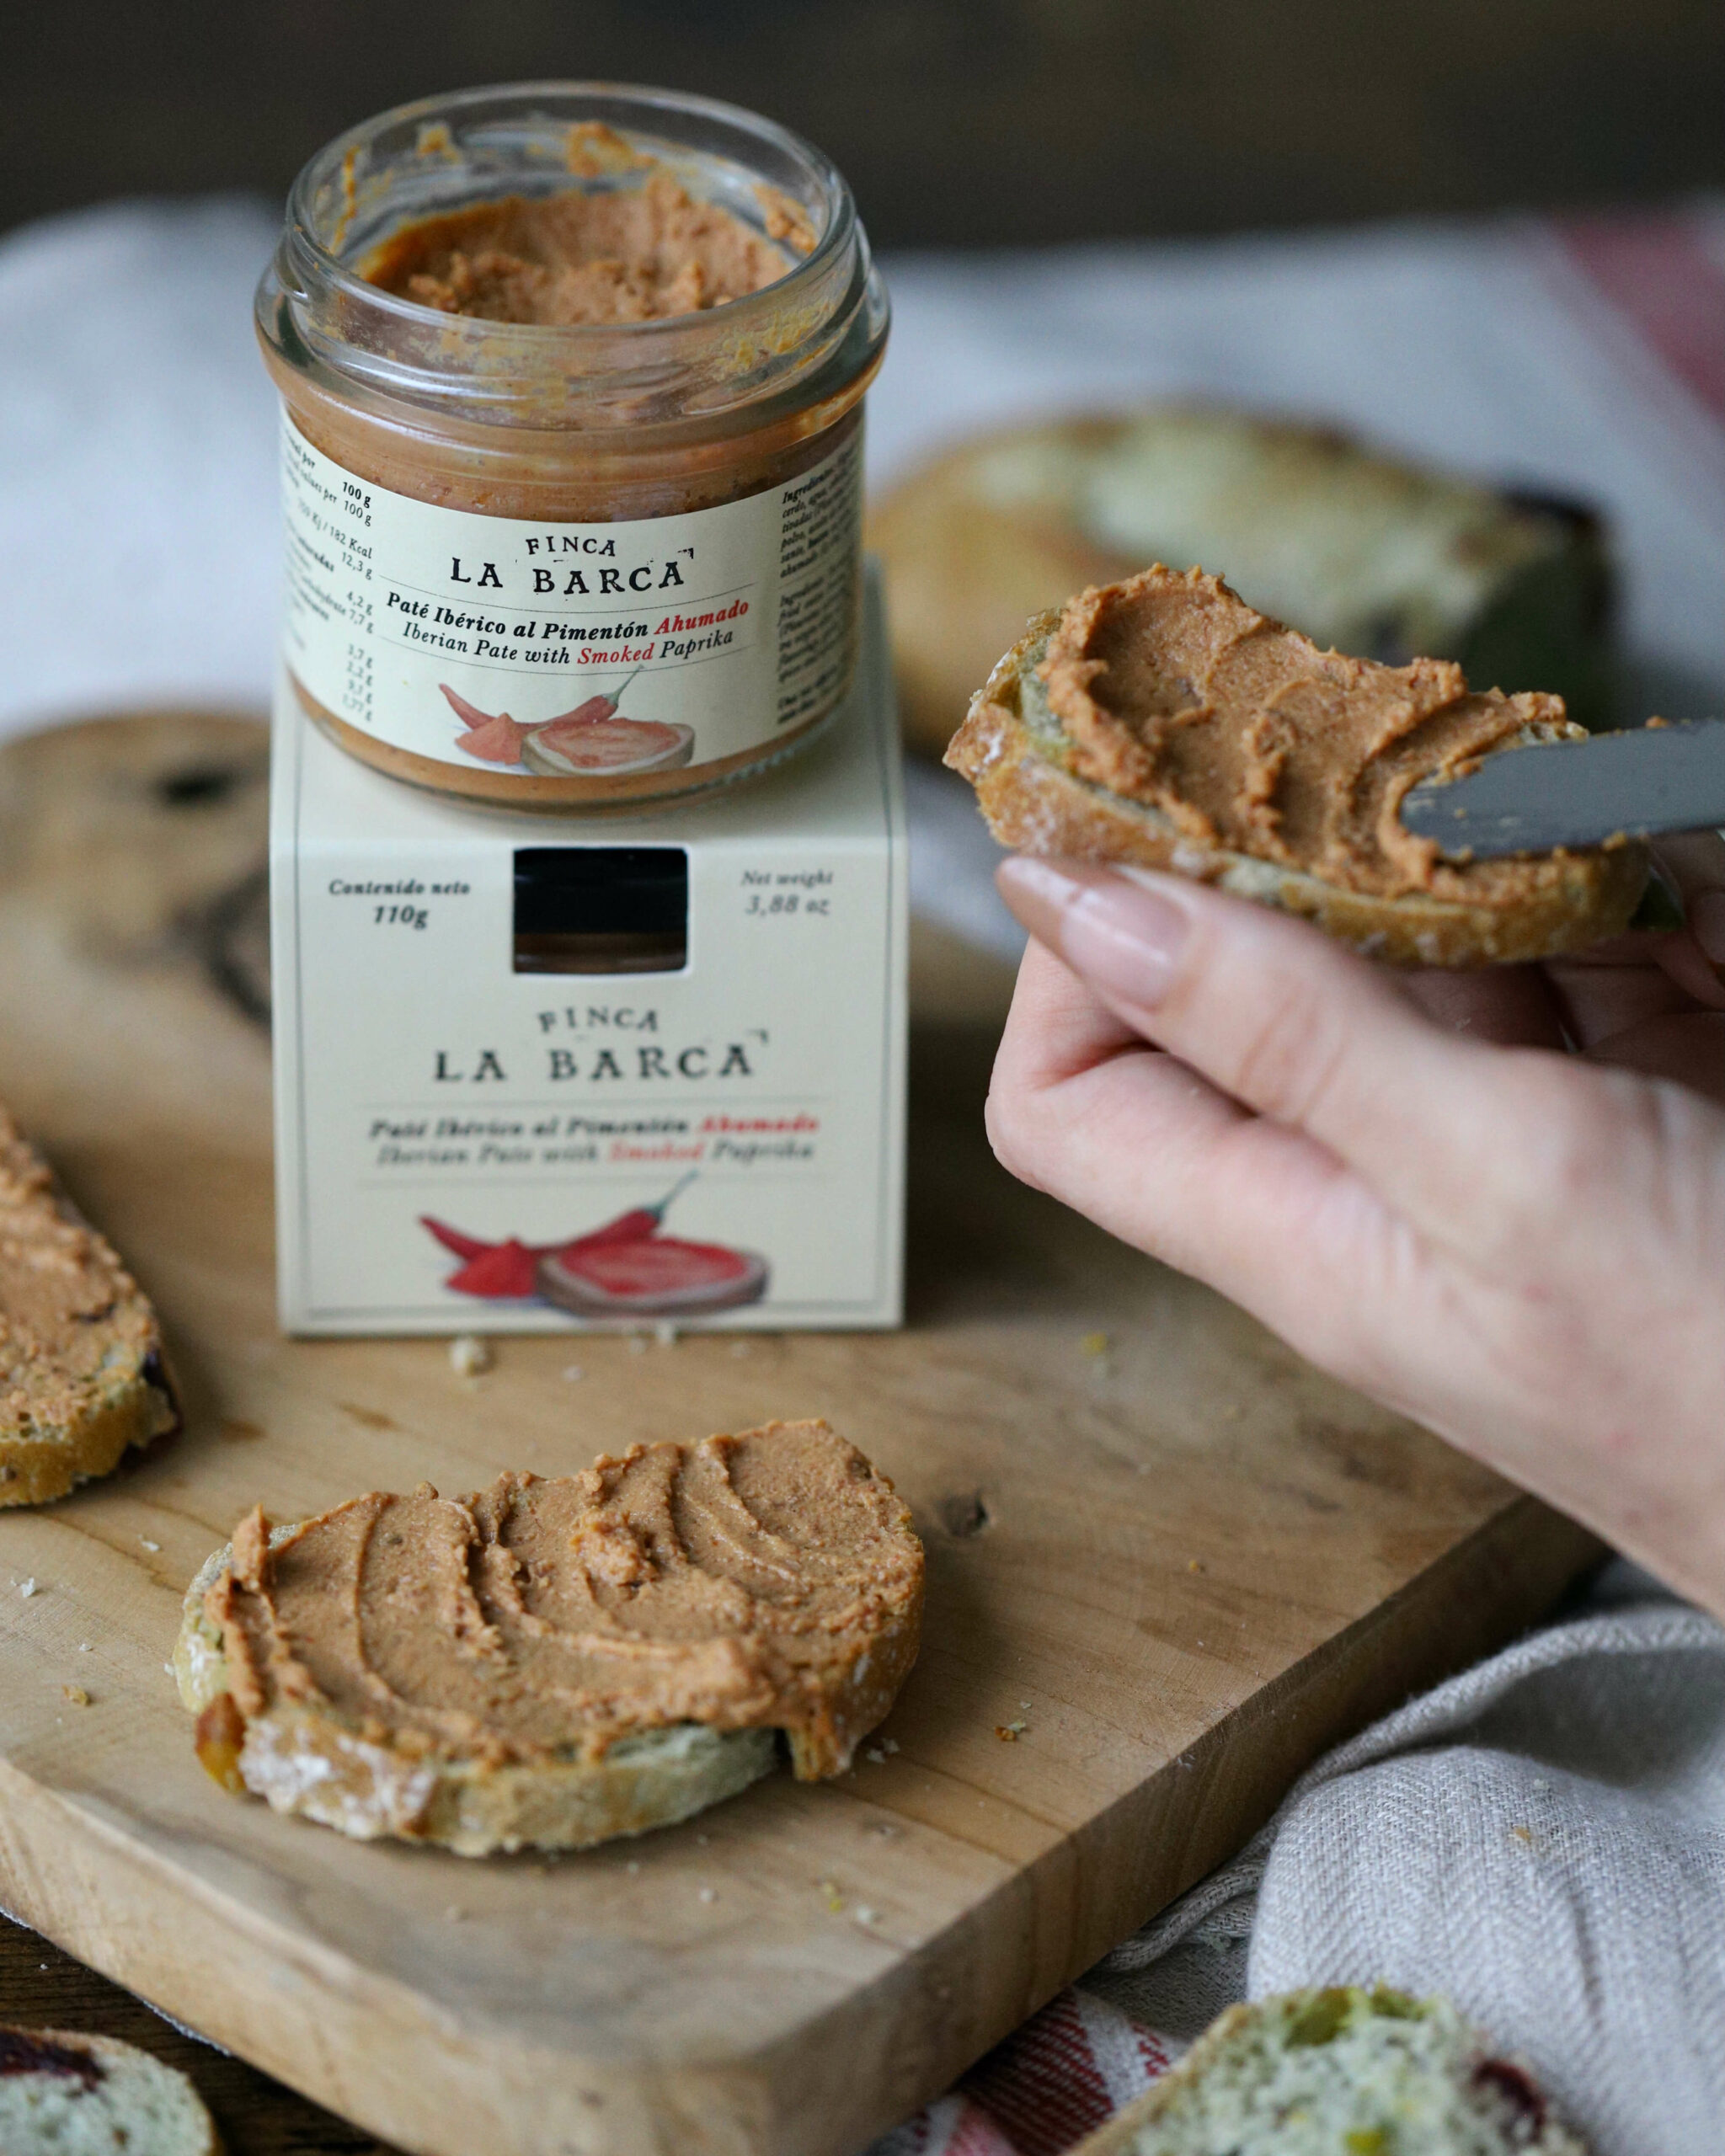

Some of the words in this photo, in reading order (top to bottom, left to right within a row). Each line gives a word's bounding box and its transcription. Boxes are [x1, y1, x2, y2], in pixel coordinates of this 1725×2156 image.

[342, 482, 361, 500] 100
[363, 495, 371, 509] g
[344, 500, 363, 519] 100
[365, 515, 371, 527] g
[330, 526, 346, 546] 182
[349, 537, 372, 559] Kcal
[526, 536, 616, 558] FINCA
[341, 552, 364, 573] 12,3
[365, 568, 372, 580] g
[451, 557, 504, 588] LA
[532, 561, 684, 595] BARCA
[387, 591, 430, 619] Paté
[434, 606, 506, 635] Ibérico
[513, 622, 536, 638] al
[542, 622, 648, 641] Pimentón
[654, 600, 750, 635] Ahumado
[403, 622, 468, 653] Iberian
[473, 639, 518, 660] Pate
[525, 647, 570, 664] with
[577, 643, 655, 664] Smoked
[660, 629, 734, 660] Paprika
[329, 878, 425, 894] Contenido
[431, 881, 471, 894] neto
[741, 870, 771, 886] Net
[777, 868, 833, 890] weight
[374, 905, 429, 930] 110g
[745, 894, 799, 918] 3,88
[806, 898, 830, 915] oz
[537, 1006, 659, 1033] FINCA
[435, 1049, 506, 1081] LA
[548, 1044, 752, 1081] BARCA
